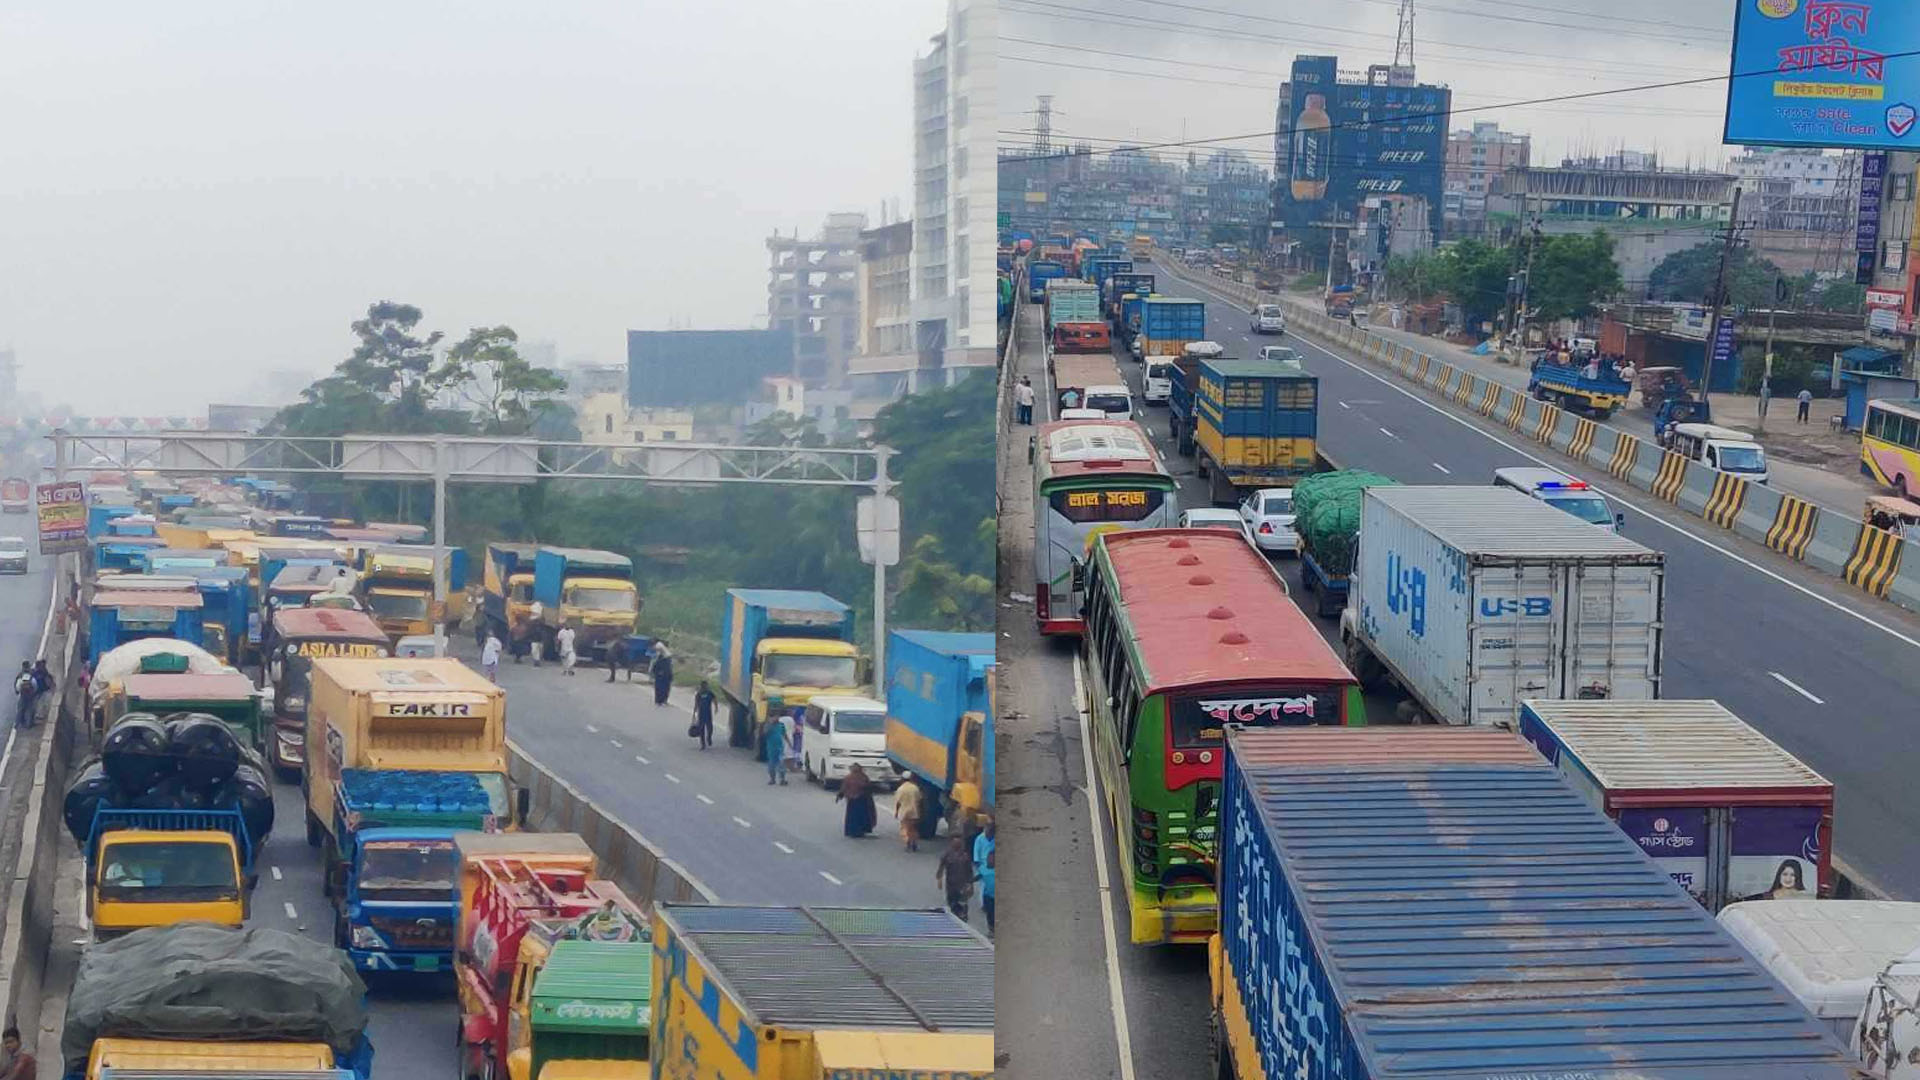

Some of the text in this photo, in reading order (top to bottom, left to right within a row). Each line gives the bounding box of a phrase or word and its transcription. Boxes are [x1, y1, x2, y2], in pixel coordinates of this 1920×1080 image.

[1068, 492, 1100, 507] লাল
[389, 703, 470, 716] FAKIR
[1198, 694, 1318, 722] স্বদেশ
